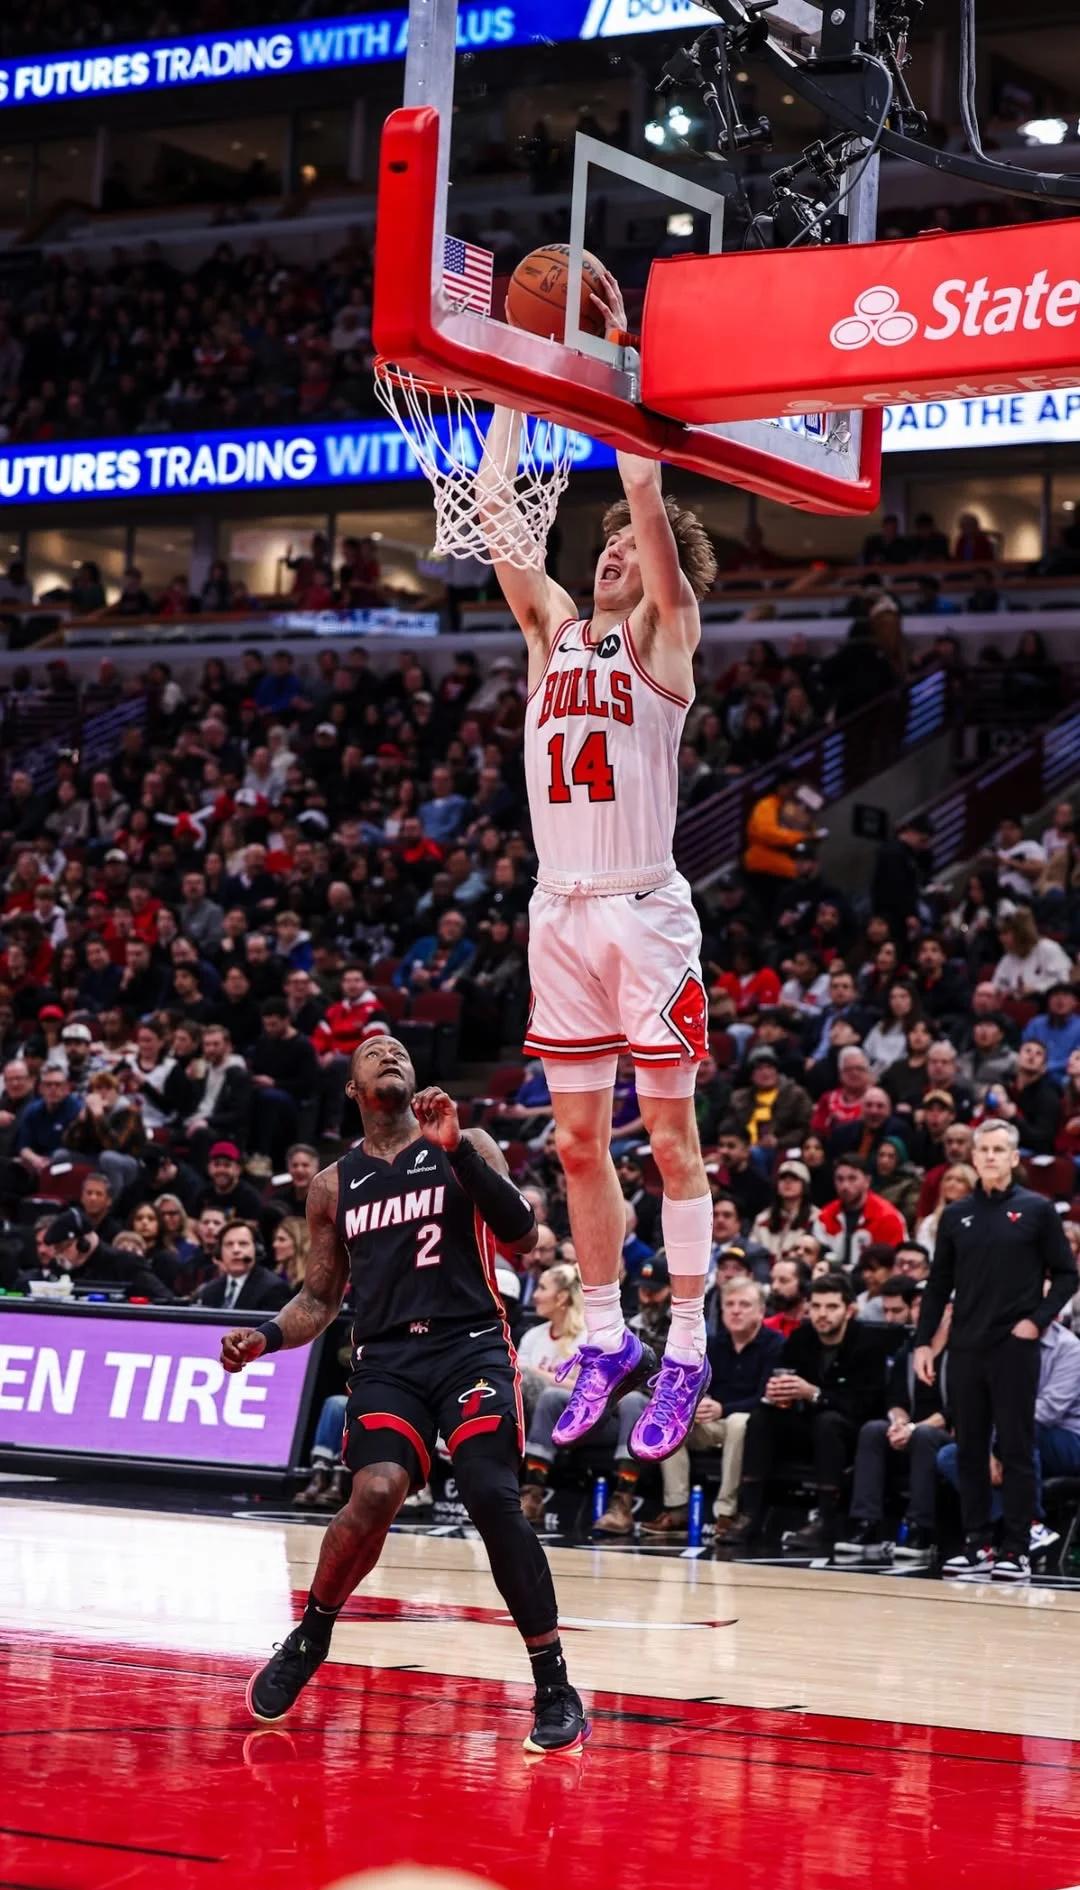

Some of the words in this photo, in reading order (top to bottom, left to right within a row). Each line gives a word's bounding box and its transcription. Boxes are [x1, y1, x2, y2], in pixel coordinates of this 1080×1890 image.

[14, 52, 150, 100] FUTURES
[152, 34, 293, 83] TRADING
[298, 21, 391, 64] WITH
[456, 7, 515, 42] LUS
[924, 269, 1080, 340] State
[960, 396, 1024, 426] THE
[0, 449, 141, 497] UTURES
[145, 438, 317, 489] TRADING
[325, 430, 437, 476] WITH
[538, 668, 634, 729] BULLS
[548, 731, 615, 804] 14
[345, 1186, 445, 1239] MIAMI
[416, 1223, 442, 1267] 2
[0, 1344, 86, 1414] EN
[105, 1352, 276, 1430] TIRE
